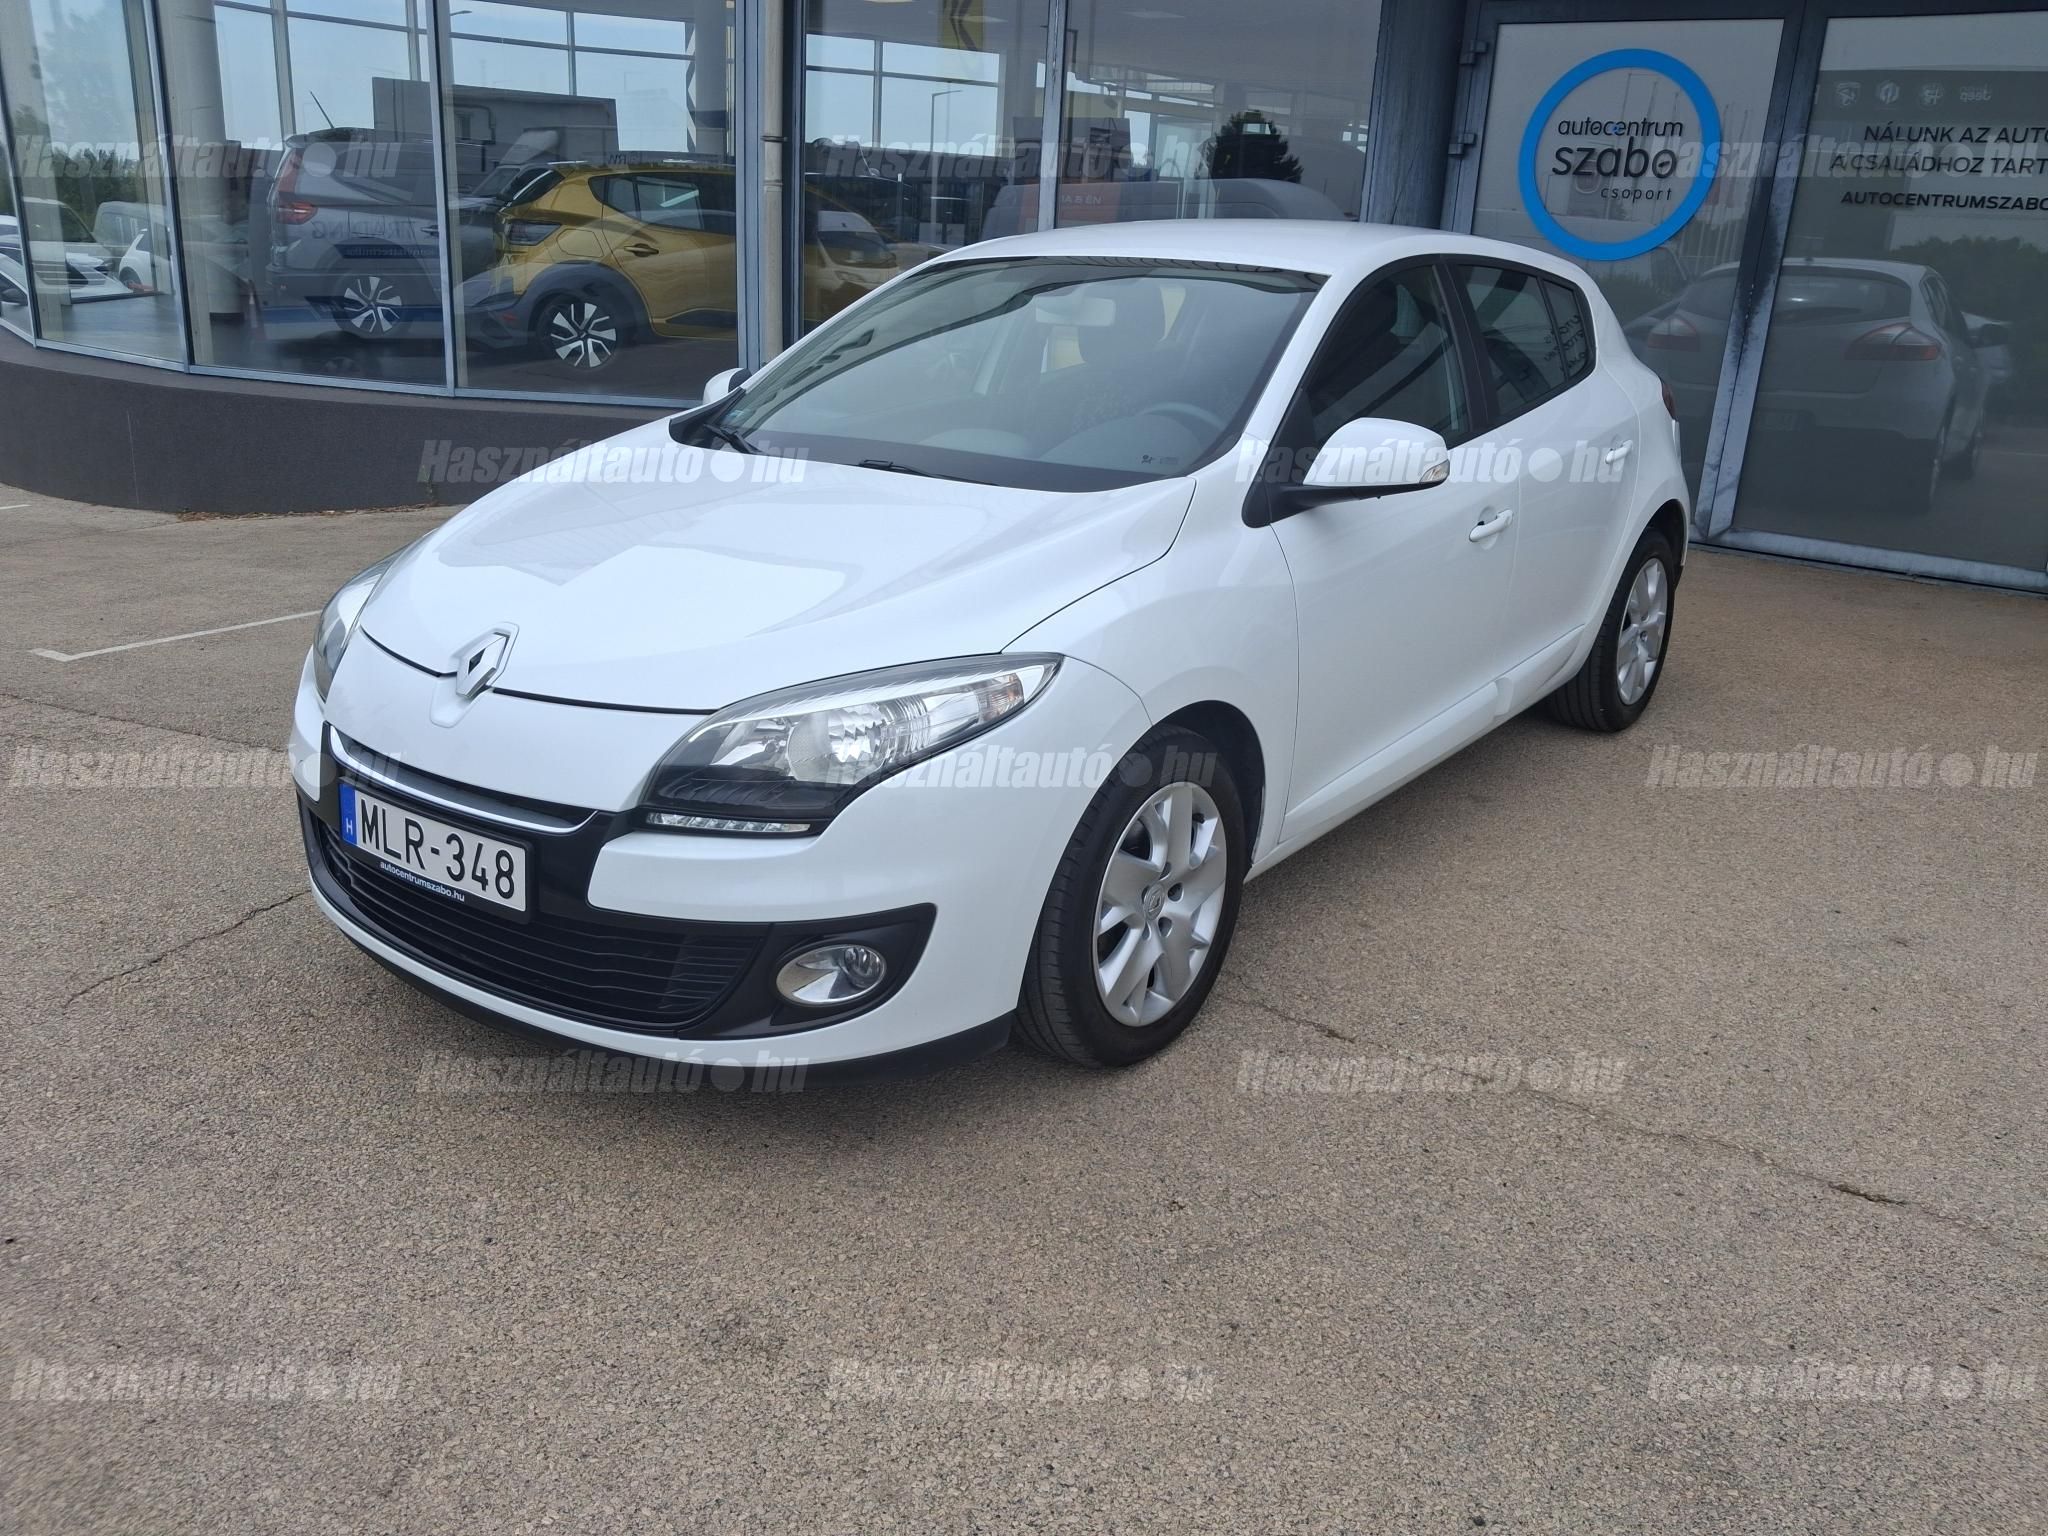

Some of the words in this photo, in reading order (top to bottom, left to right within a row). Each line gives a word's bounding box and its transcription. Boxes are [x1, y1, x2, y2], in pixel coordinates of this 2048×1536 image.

[1557, 116, 1684, 137] autocentrum
[1864, 121, 1956, 143] NÁLUNK
[1958, 127, 1992, 143] AZ
[1994, 127, 2048, 144] AUT
[1829, 155, 1847, 170] A
[1849, 151, 1984, 173] CSALÁDHOZ
[1600, 187, 1673, 204] csoport
[345, 817, 354, 836] H
[359, 798, 516, 900] MLR-348
[379, 860, 466, 903] autocentrumszabo.hu
